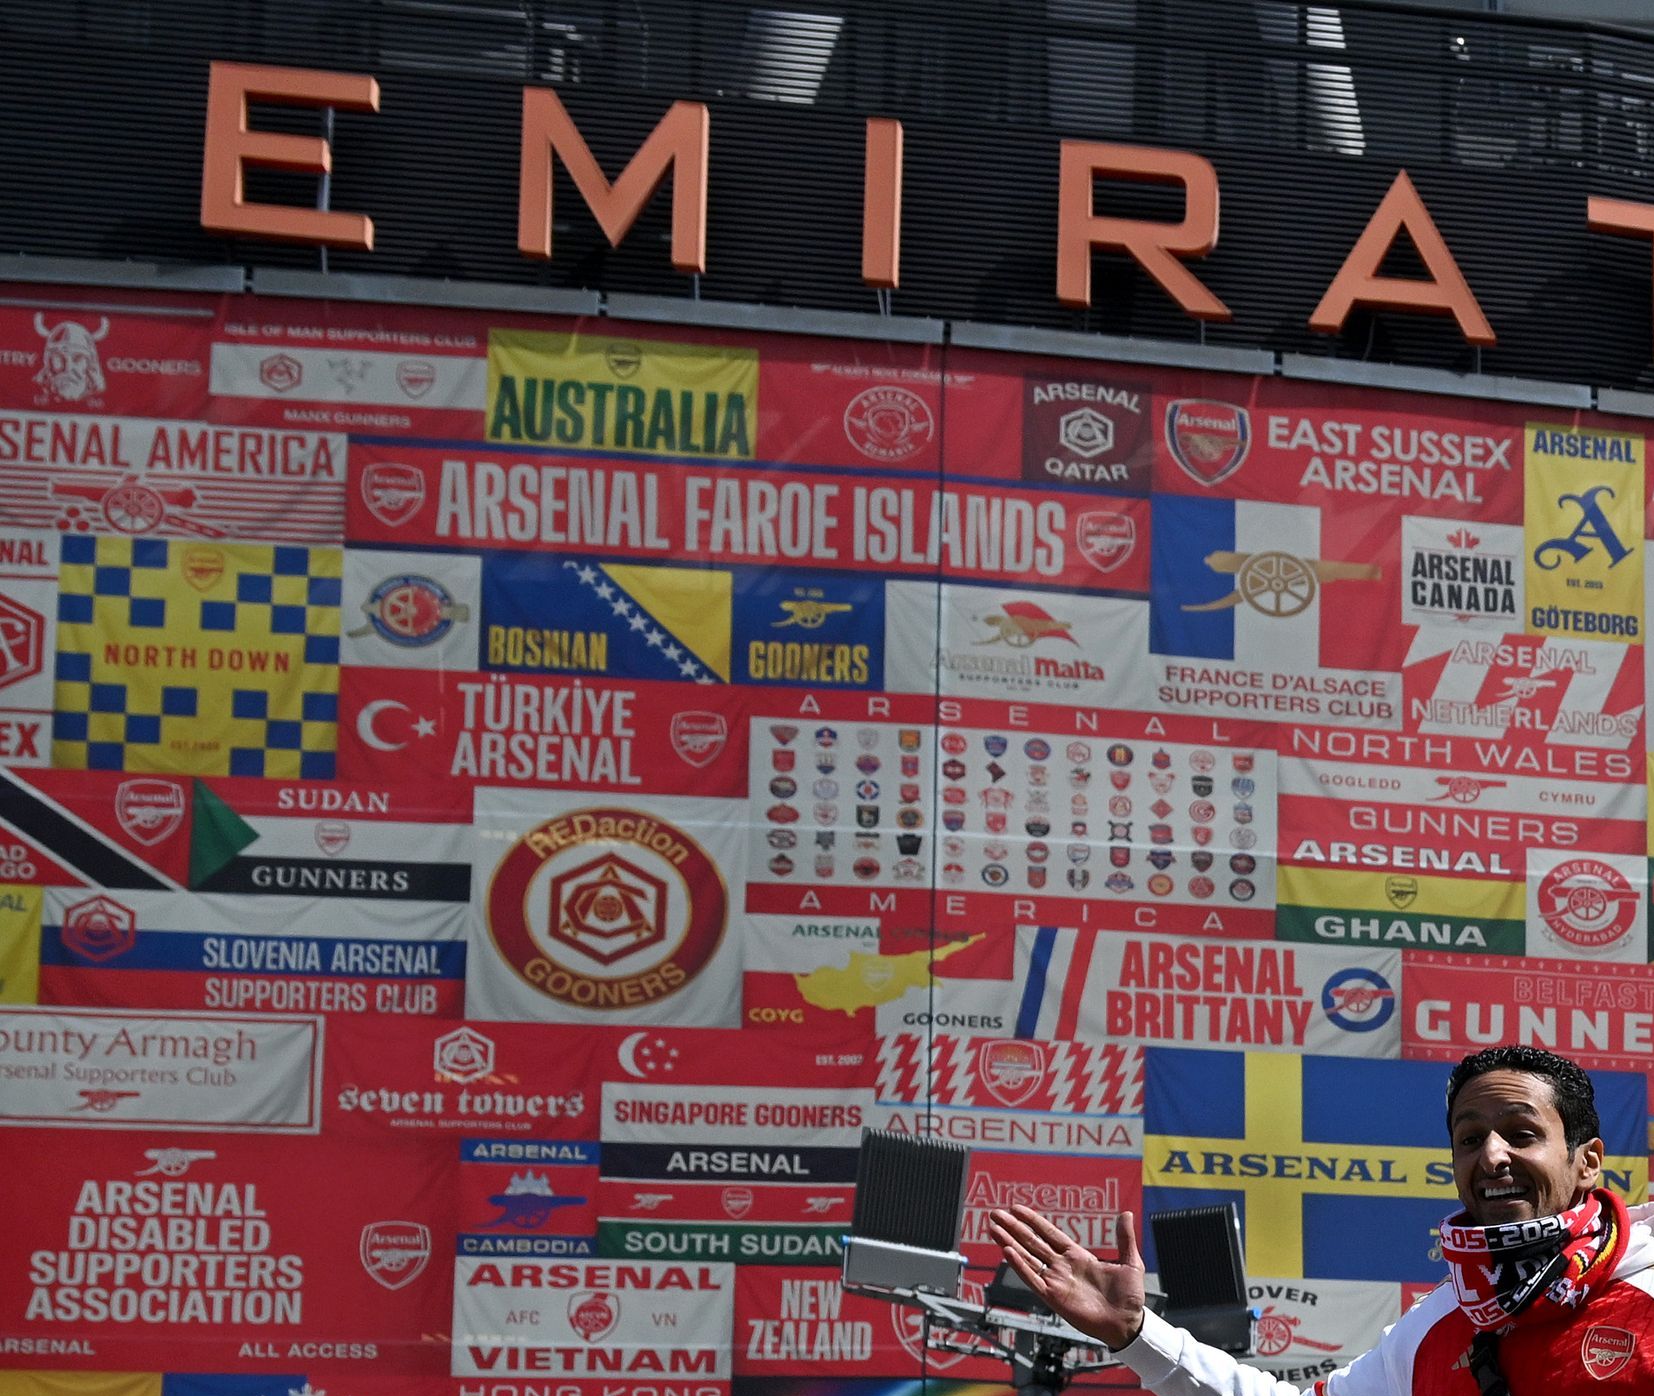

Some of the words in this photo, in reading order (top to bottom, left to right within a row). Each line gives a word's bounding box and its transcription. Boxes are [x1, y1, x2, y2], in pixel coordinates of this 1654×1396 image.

[224, 323, 252, 336] ISLE
[256, 325, 282, 338] OF
[286, 326, 322, 340] MAN
[328, 328, 429, 346] SUPPORTERS
[434, 334, 476, 349] CLUB
[284, 409, 328, 423] MANX
[334, 411, 411, 428] GUNNERS
[489, 374, 751, 459] AUSTRALIA
[1268, 416, 1362, 455] EAST
[1371, 425, 1511, 471] SUSSEX
[1044, 456, 1128, 481] QATAR
[435, 459, 669, 551] ARSENAL
[685, 477, 838, 560] FAROE
[853, 487, 1066, 577] ISLANDS
[1412, 581, 1516, 614] CANADA
[1532, 605, 1639, 638] GÖTEBORG
[104, 642, 196, 670] NORTH
[208, 648, 289, 673] DOWN
[488, 625, 607, 671] BOSNIAN
[749, 641, 869, 684] GOONERS
[1034, 650, 1104, 682] Malta
[1165, 664, 1266, 694] FRANCE
[1271, 672, 1386, 698] D'ALSACE
[1293, 728, 1452, 764] NORTH
[1475, 741, 1631, 776] WALES
[278, 789, 389, 814] SUDAN
[1319, 773, 1400, 791] GOGLEDD
[1540, 791, 1596, 804] CYMRU
[1349, 806, 1578, 844] GUNNERS
[252, 865, 409, 891] GUNNERS
[1314, 915, 1488, 946] GHANA
[202, 939, 320, 971] SLOVENIA
[331, 944, 440, 975] ARSENAL
[205, 979, 366, 1011] SUPPORTERS
[376, 984, 437, 1013] CLUB
[750, 1008, 804, 1024] COYG
[904, 1012, 1002, 1030] GOONERS
[1106, 990, 1314, 1047] BRITTANY
[106, 1028, 256, 1063] Armagh
[64, 1063, 178, 1085] Supporters
[186, 1066, 235, 1086] Club
[615, 1100, 746, 1126] SINGAPORE
[755, 1104, 862, 1128] GOONERS
[68, 1218, 270, 1252] DISABLED
[464, 1238, 590, 1256] CAMBODIA
[29, 1252, 303, 1289] SUPPORTERS
[25, 1288, 301, 1325] ASSOCIATION
[781, 1280, 841, 1318] NEW
[239, 1344, 279, 1357] ALL
[288, 1344, 377, 1358] ACCESS
[746, 1320, 872, 1361] ZEALAND
[468, 1346, 716, 1373] VIETNAM
